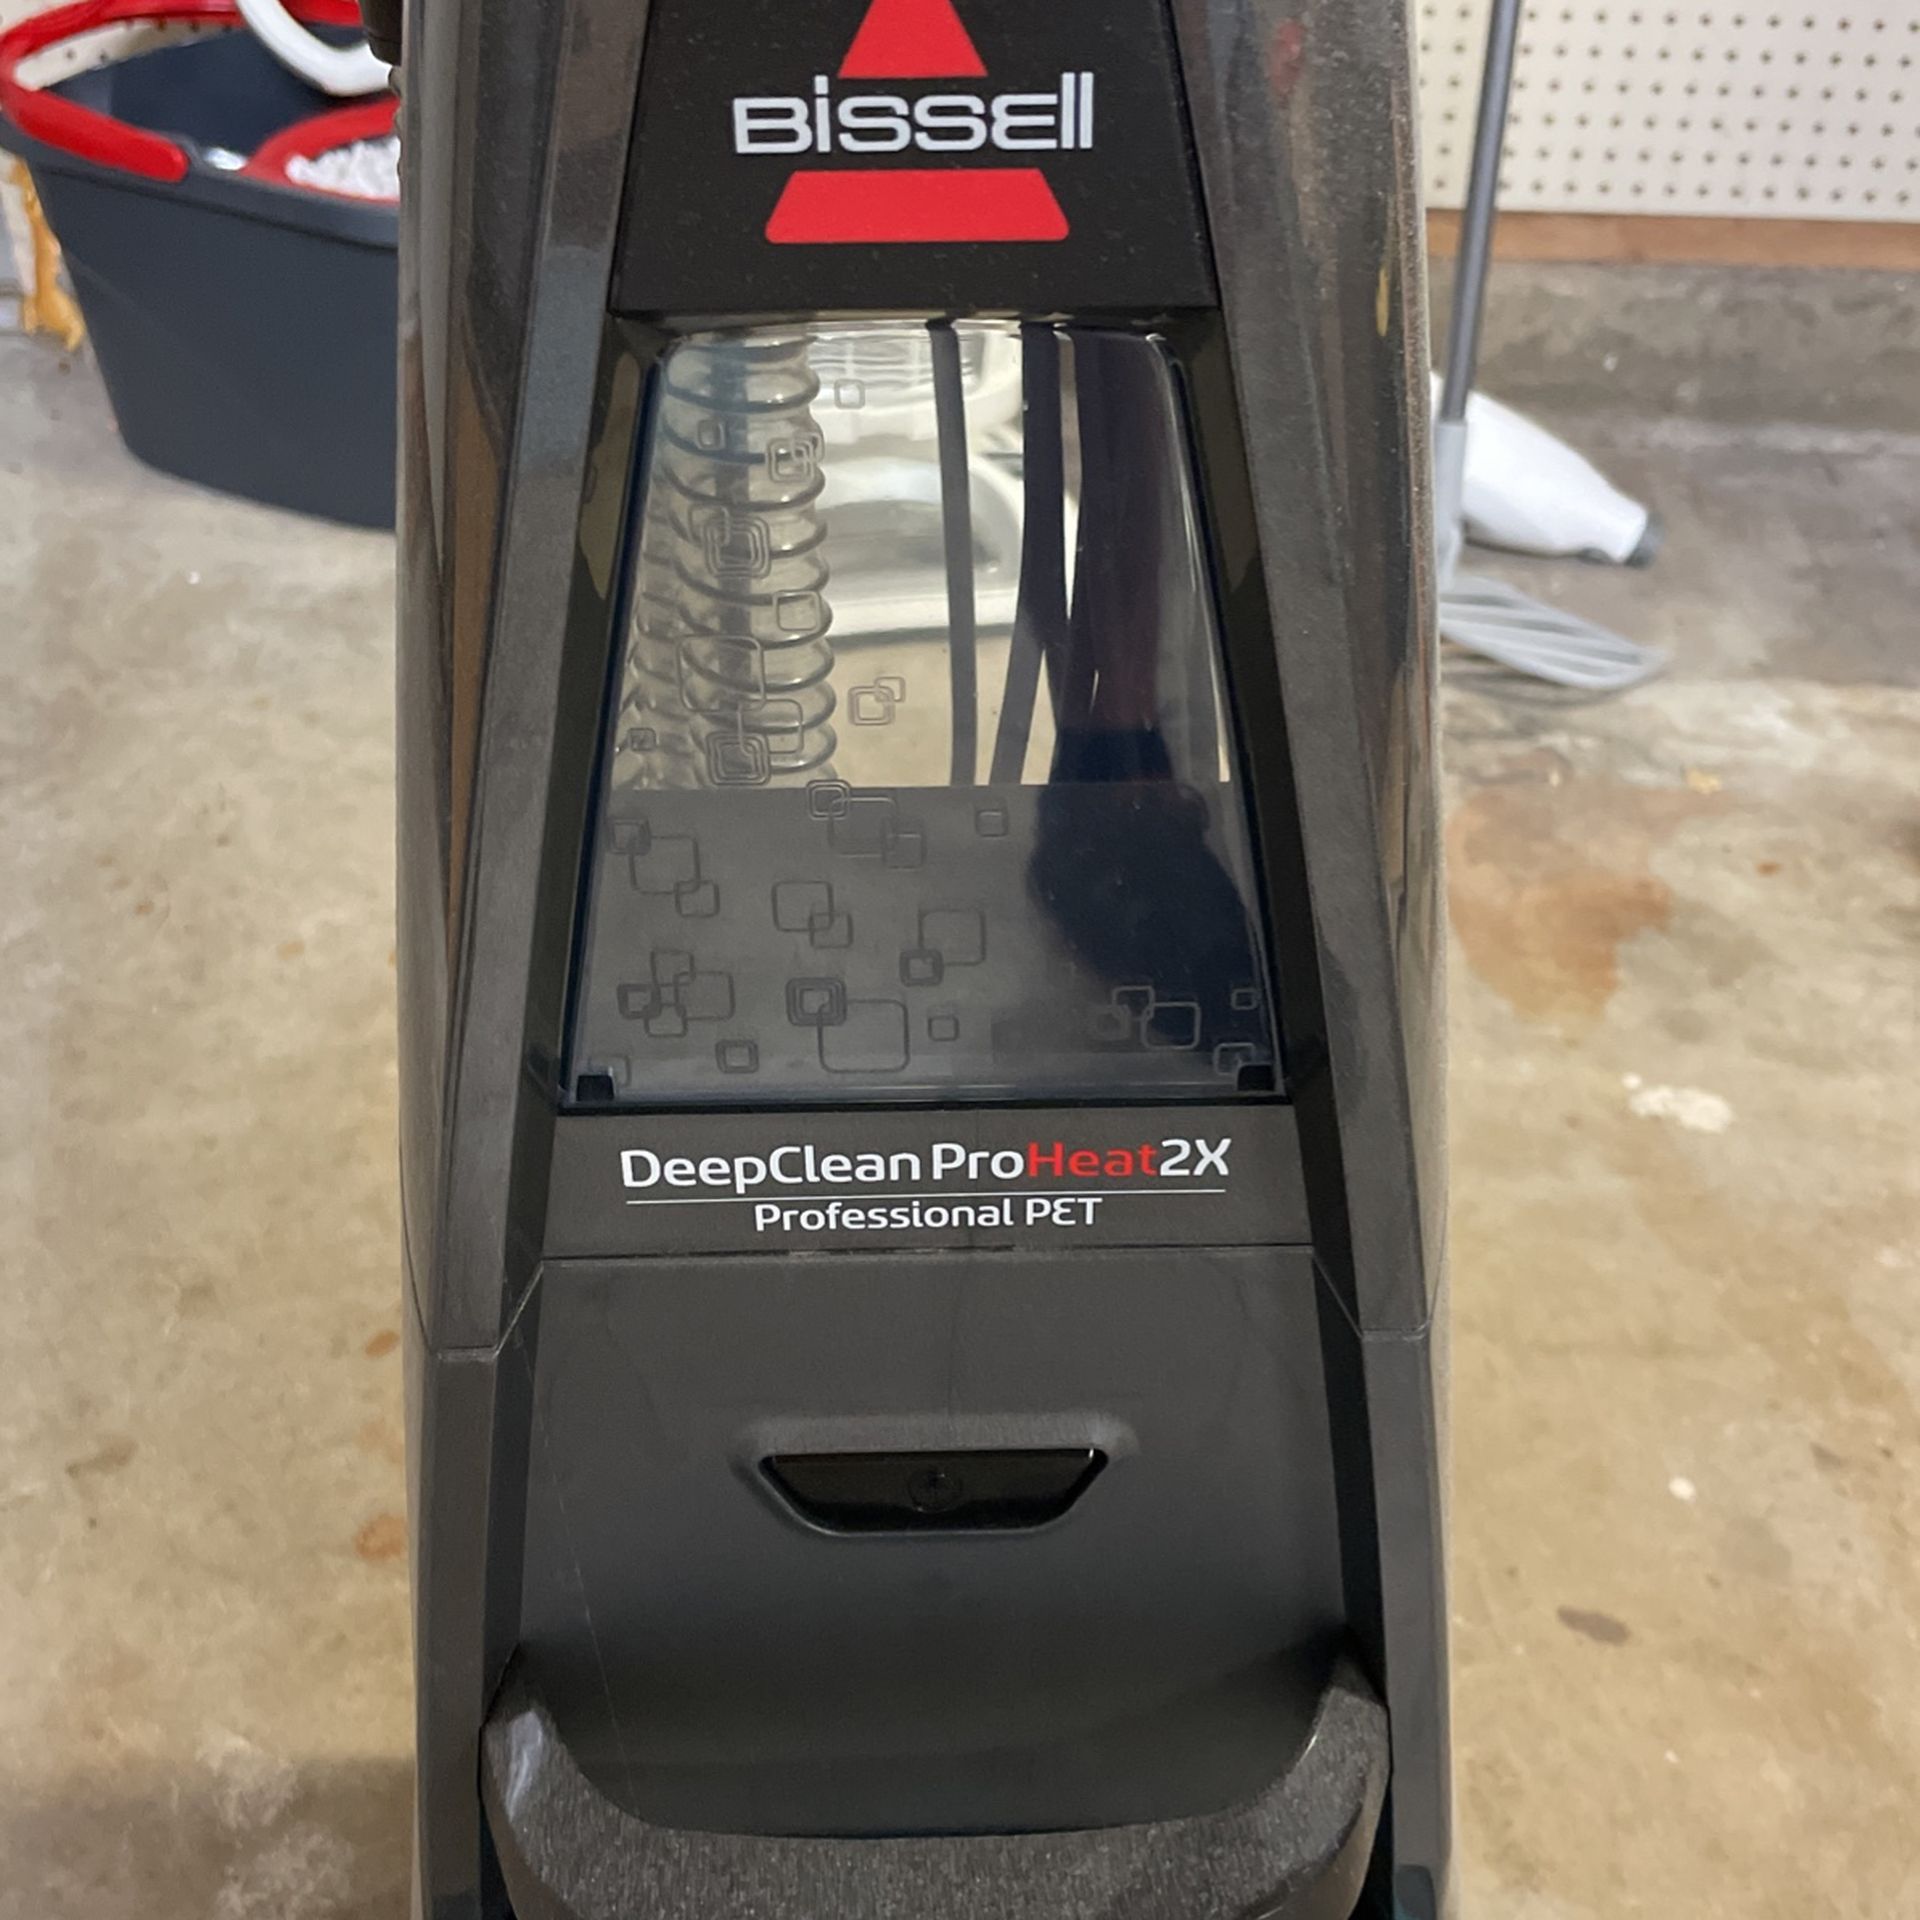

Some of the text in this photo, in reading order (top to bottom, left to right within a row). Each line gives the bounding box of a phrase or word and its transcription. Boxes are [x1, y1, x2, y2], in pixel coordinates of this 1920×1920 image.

[620, 1138, 1232, 1194] DeepClean ProHeat2X
[754, 1197, 1103, 1233] Professional PET
